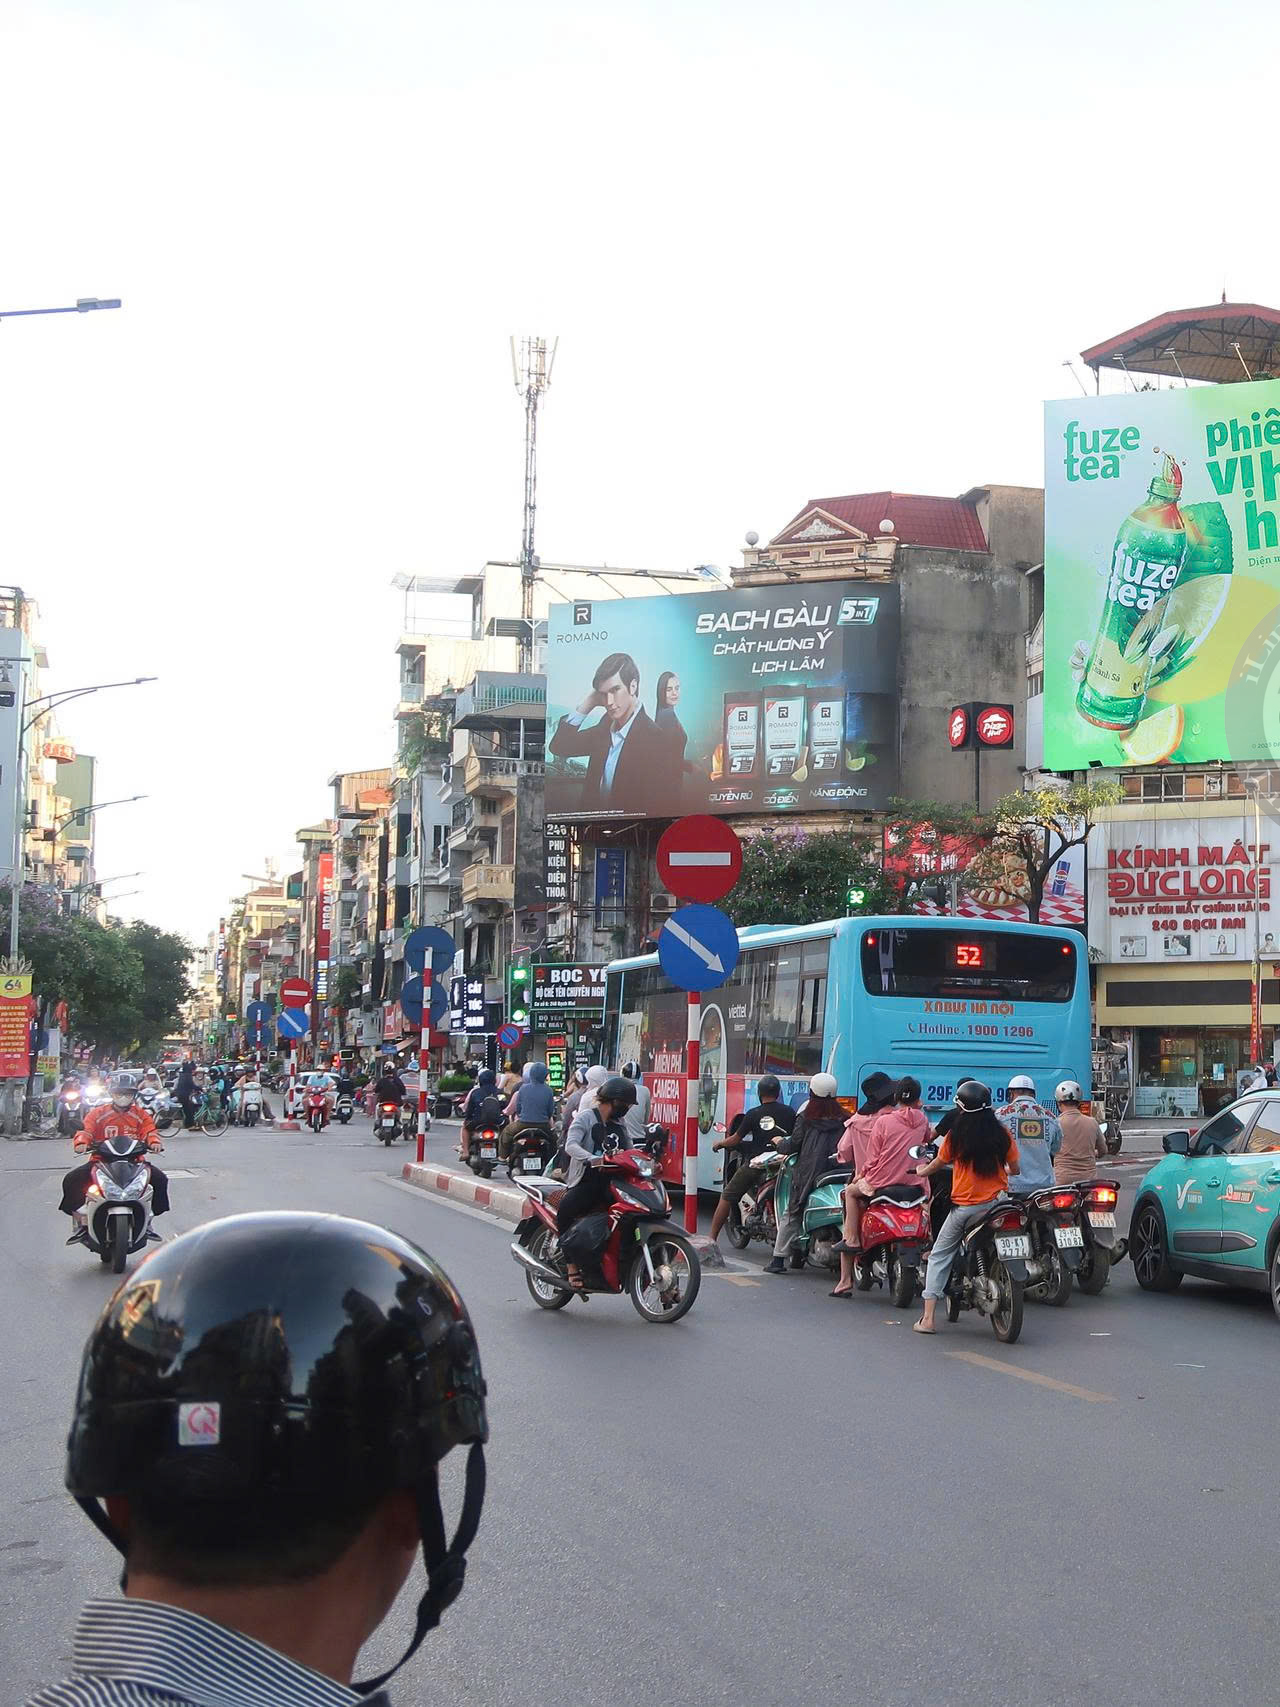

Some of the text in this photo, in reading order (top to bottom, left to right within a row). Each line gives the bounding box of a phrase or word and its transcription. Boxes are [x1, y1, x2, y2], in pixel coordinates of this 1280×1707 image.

[1063, 421, 1140, 454] fuze
[1064, 453, 1122, 481] tea
[1206, 455, 1254, 497] vị
[1115, 543, 1177, 589] fuze
[1248, 557, 1271, 569] Diện
[1109, 575, 1157, 610] tea
[696, 600, 832, 639] SẠCH GÀU
[556, 631, 609, 643] ROMANO
[713, 628, 833, 655] CHẤT HƯƠNG Ý
[752, 656, 825, 676] LỊCH LÃM
[549, 840, 565, 853] PHỤ
[1108, 839, 1270, 869] KÍNH MẮT
[548, 854, 566, 869] KIỆN
[548, 870, 566, 885] ĐIỆN
[323, 877, 333, 904] MART
[1109, 905, 1128, 918] ĐẠI
[1131, 903, 1145, 915] LÝ
[1147, 902, 1173, 914] KÍNH
[1175, 900, 1200, 914] MẮT
[1202, 901, 1235, 914] CHÍNH
[1152, 918, 1246, 932] 240 BẠCH MAI
[957, 946, 980, 965] 52
[4, 979, 22, 991] 64
[550, 969, 582, 985] BỌC
[567, 985, 590, 998] CHUYÊN
[728, 1003, 747, 1018] viettel
[918, 1023, 1034, 1037] Hotline 1900 1296
[653, 1079, 680, 1099] CAMERA
[653, 1103, 679, 1124] AN NINH
